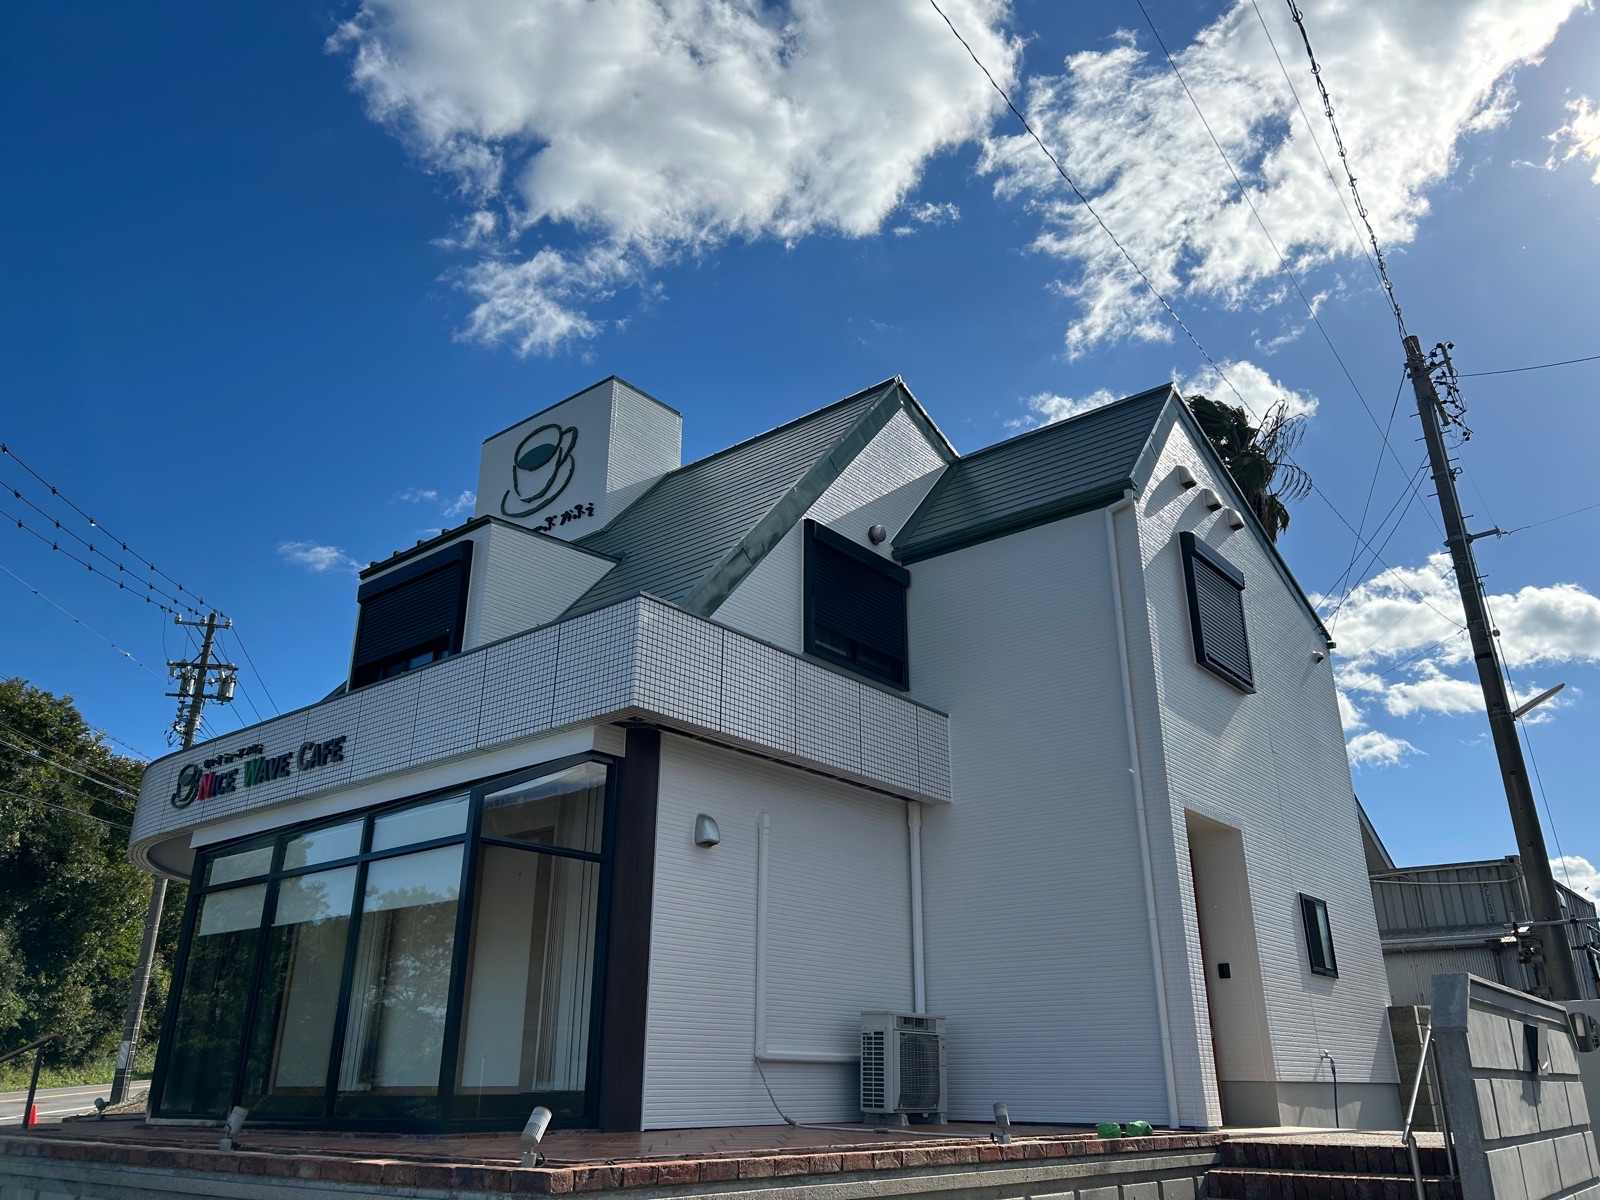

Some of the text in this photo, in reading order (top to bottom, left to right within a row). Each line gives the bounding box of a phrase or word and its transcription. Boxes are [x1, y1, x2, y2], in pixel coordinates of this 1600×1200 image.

[197, 735, 346, 800] NICE WAVE CAFE
